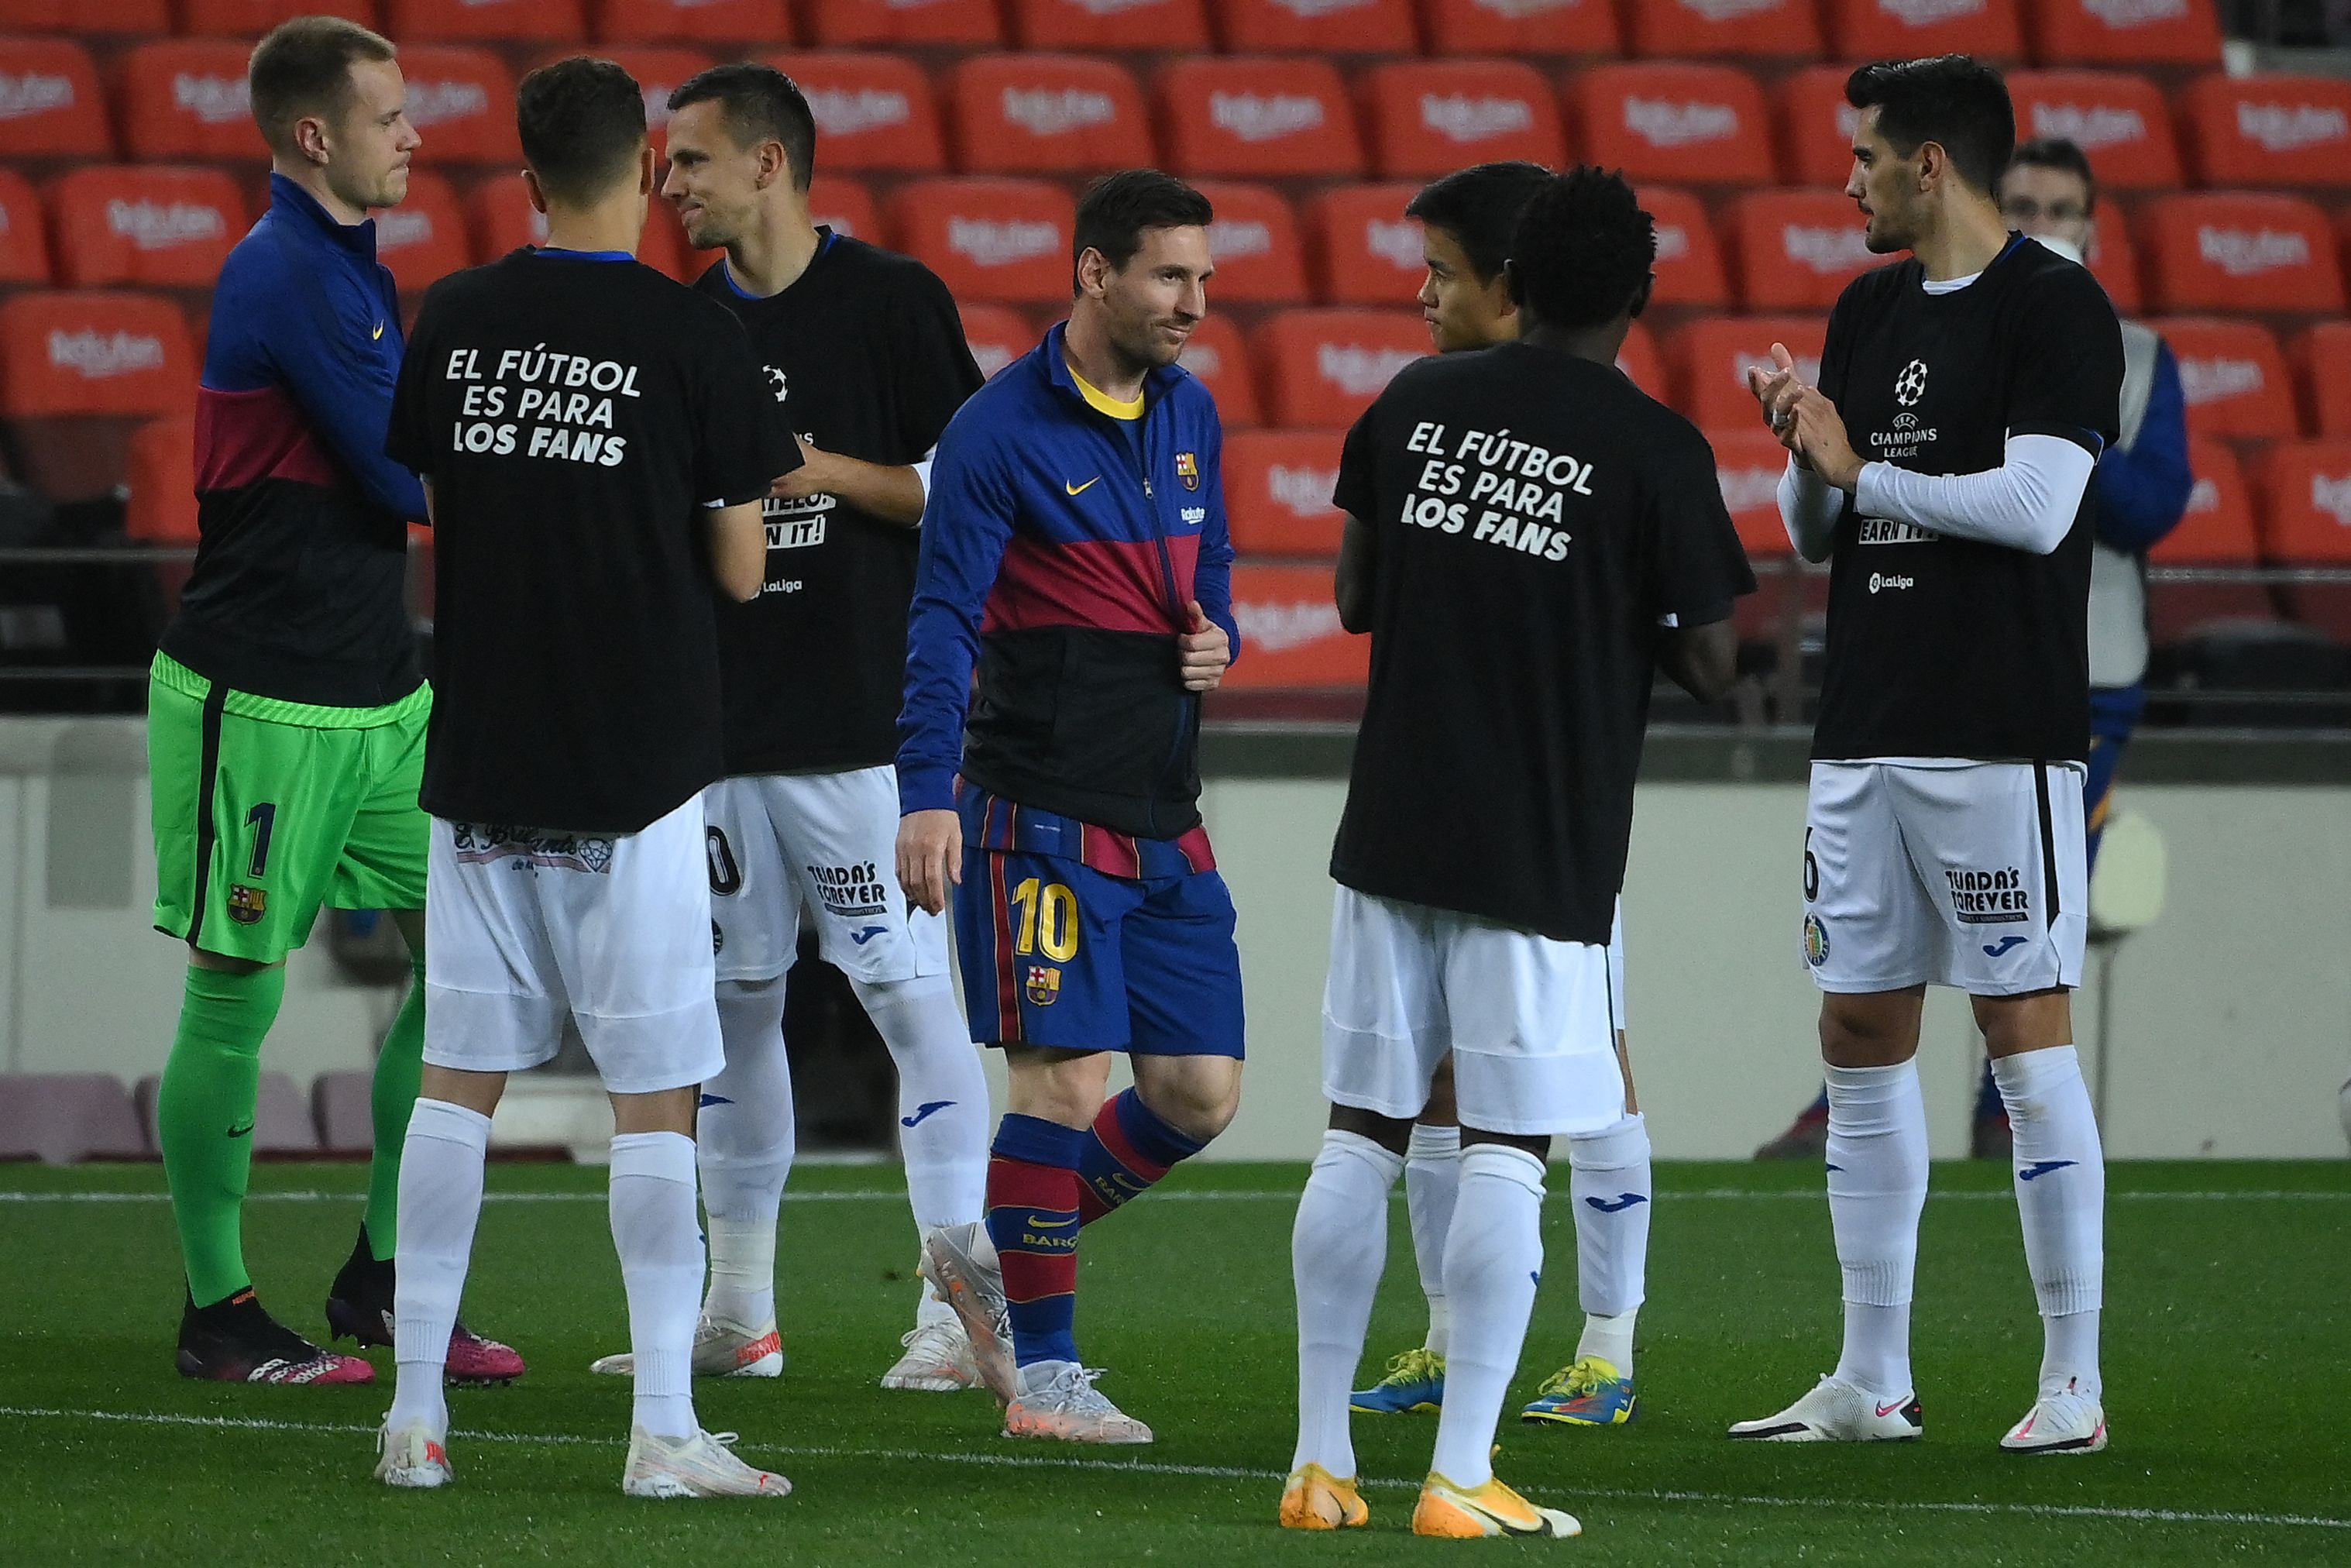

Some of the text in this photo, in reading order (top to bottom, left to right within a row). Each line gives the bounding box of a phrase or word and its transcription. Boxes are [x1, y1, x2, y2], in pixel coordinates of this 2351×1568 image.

[446, 342, 641, 398] EL FÚTBOL
[462, 386, 613, 429] ES PARA
[453, 421, 627, 466] LOS FANS
[1406, 421, 1594, 496] EL FÚTBOL
[1418, 459, 1564, 524] ES PARA
[790, 517, 822, 545] IT!
[1400, 493, 1573, 562] LOS FANS
[1861, 521, 1899, 542] EARN
[763, 579, 803, 593] LaLiga
[1882, 574, 1914, 590] LaLiga
[244, 802, 277, 880] 1
[1011, 877, 1080, 963] 10
